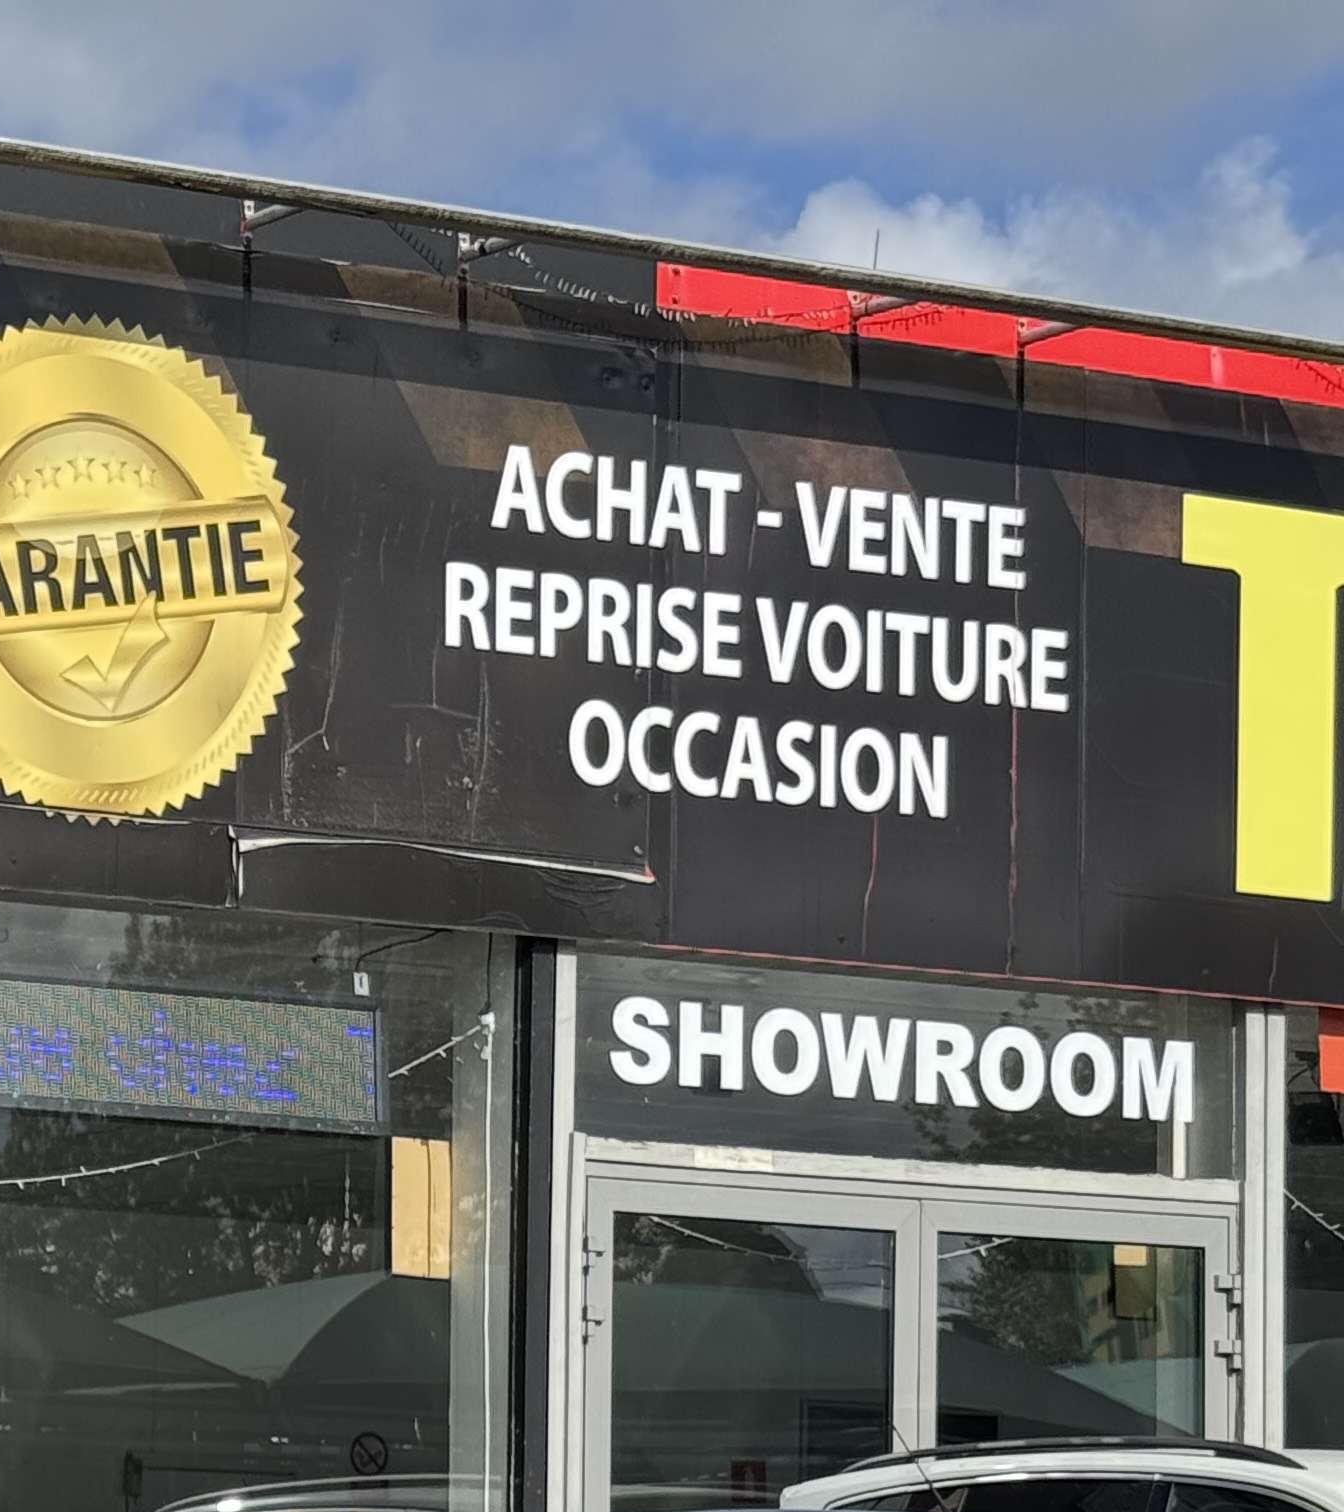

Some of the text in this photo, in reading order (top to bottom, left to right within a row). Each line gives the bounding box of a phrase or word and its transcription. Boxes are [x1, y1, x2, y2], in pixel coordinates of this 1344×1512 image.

[491, 444, 1027, 591] ACHAT - VENTE
[444, 561, 1070, 713] REPRISE VOITURE
[568, 700, 949, 820] OCCASION
[609, 997, 1194, 1126] SHOWROOM
